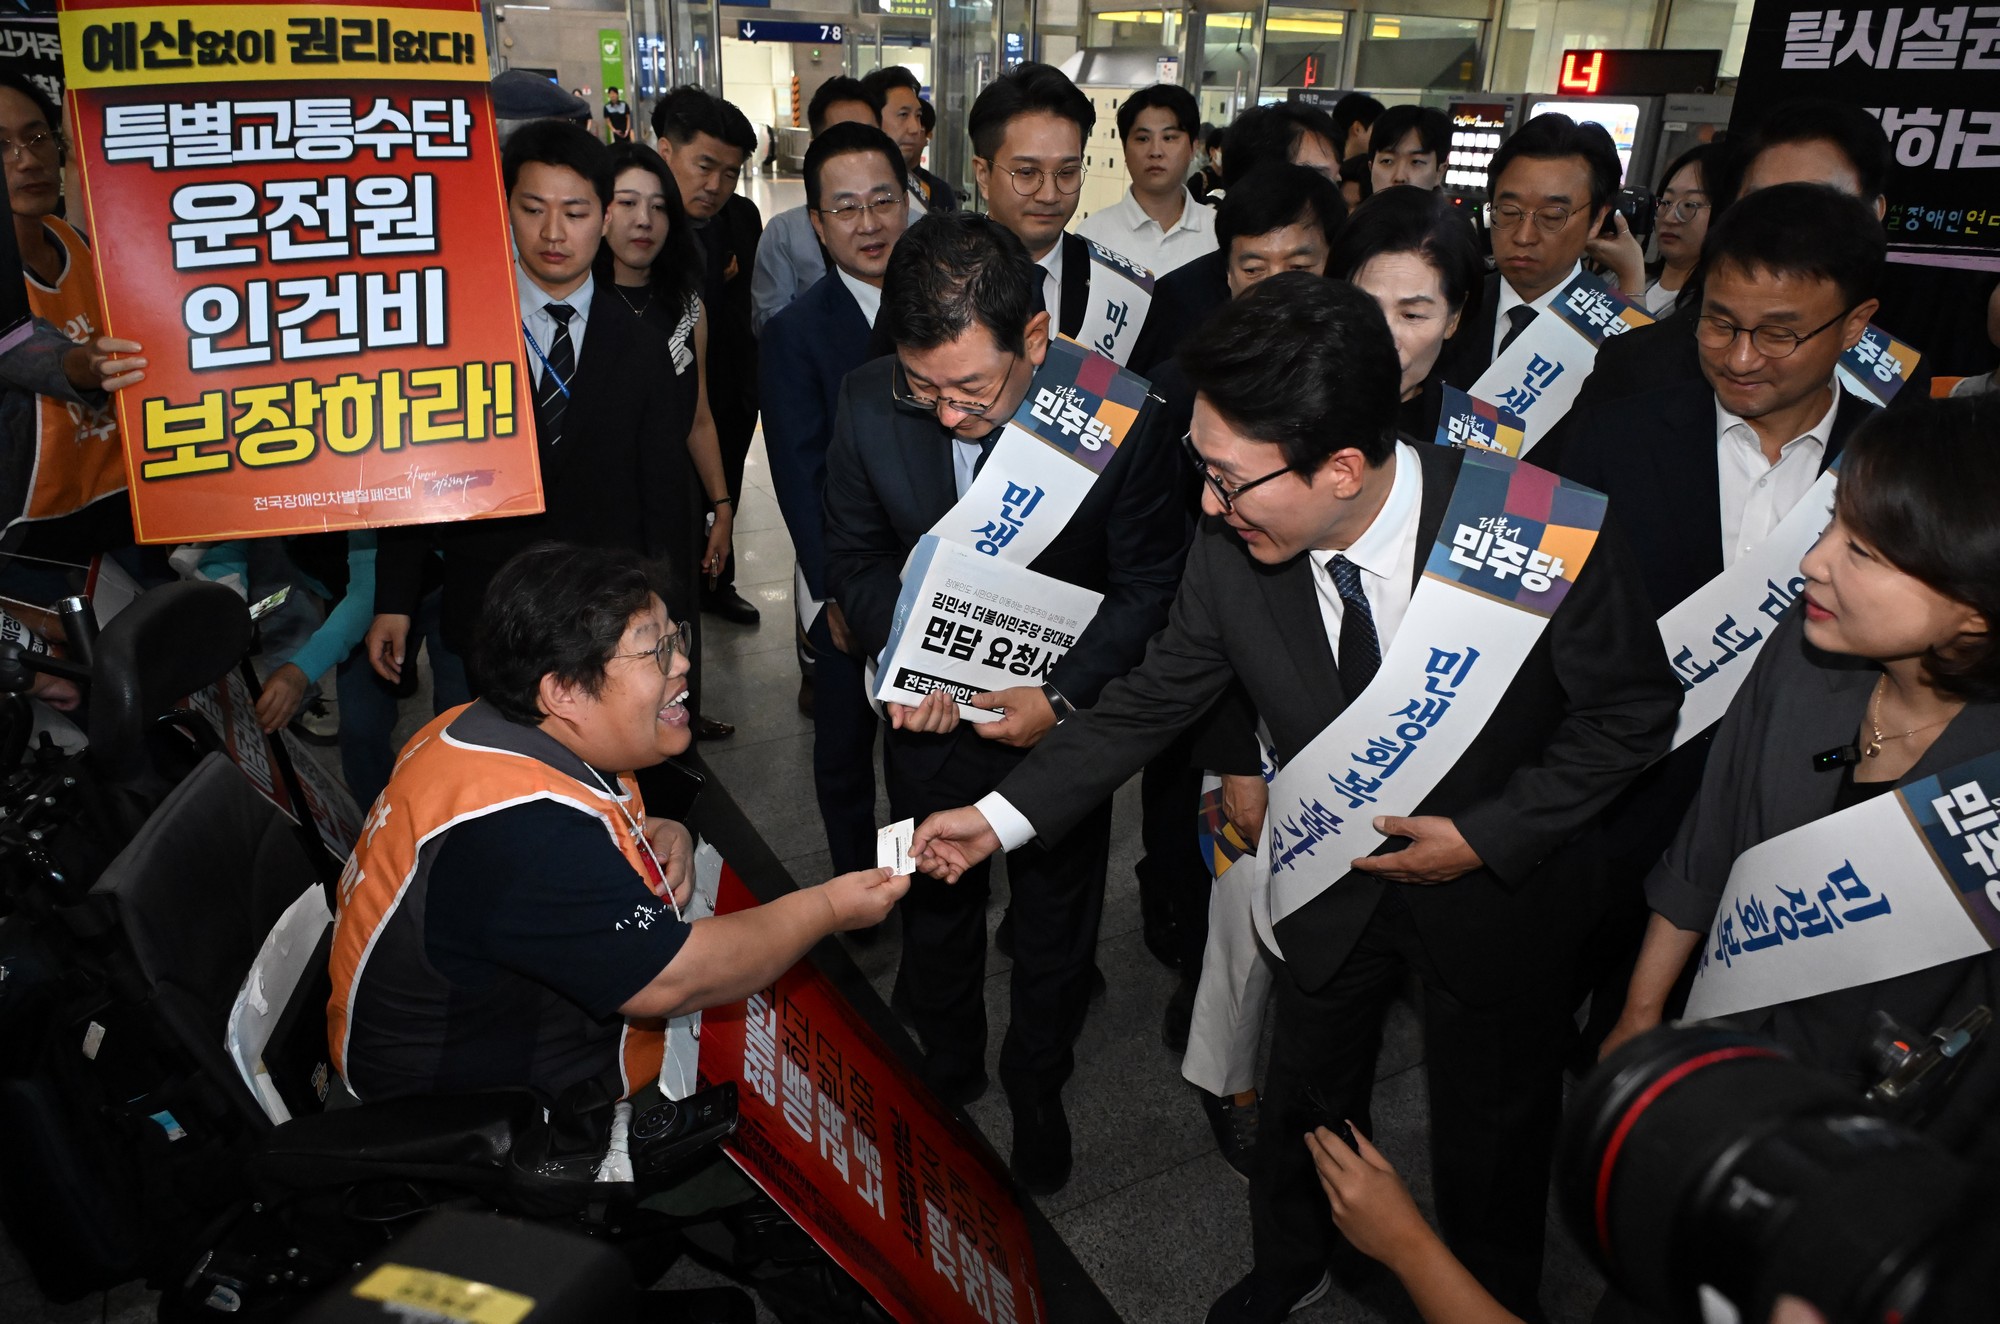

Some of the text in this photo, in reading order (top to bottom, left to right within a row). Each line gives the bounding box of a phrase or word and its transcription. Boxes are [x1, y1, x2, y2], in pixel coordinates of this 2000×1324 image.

[82, 16, 476, 72] 예산없이 권리없다!
[1562, 52, 1603, 93] 너
[104, 98, 471, 168] 특별교통수단
[169, 174, 436, 269] 운전원
[184, 268, 445, 370] 인건비
[1846, 336, 1902, 382] 주당
[141, 363, 515, 480] 보장하라!
[1029, 387, 1112, 453] 민주당
[1054, 384, 1085, 408] 더불어
[253, 486, 412, 511] 전국장애인차별철폐연대
[971, 479, 1046, 557] 민생
[1478, 517, 1522, 542] 더불어
[1448, 523, 1566, 594] 민주당
[921, 616, 983, 662] 면담
[932, 592, 1076, 650] 김민석 더불어민주당 당대표
[1328, 646, 1481, 809] 민생회복
[1715, 858, 1892, 968] 민생회복
[782, 995, 813, 1143] 이동하고
[817, 1031, 848, 1183] 교육받고
[851, 1070, 885, 1220] 노동하며
